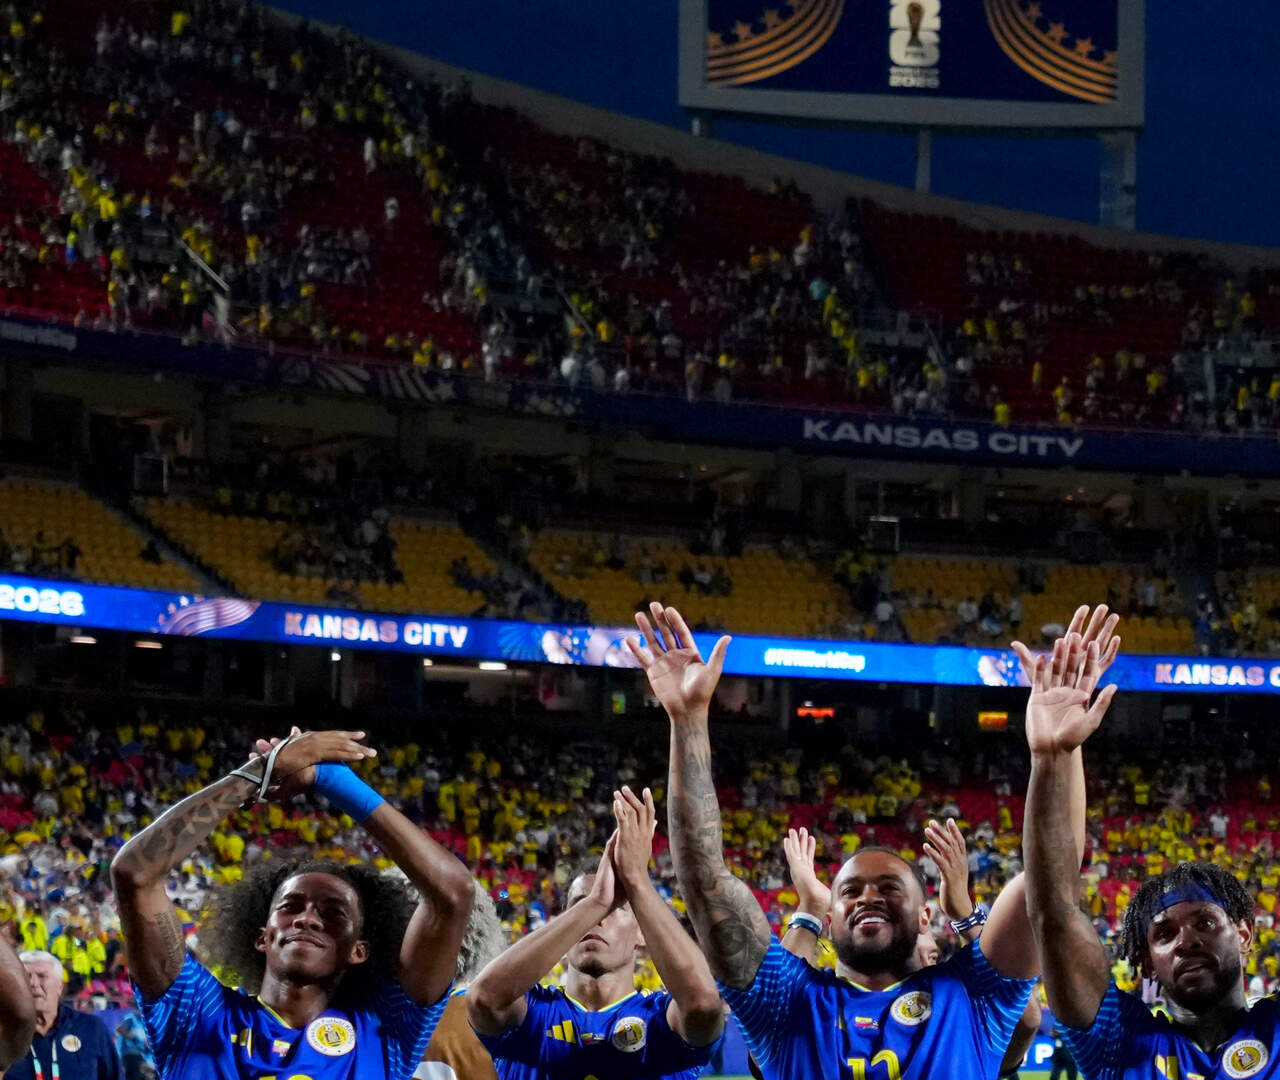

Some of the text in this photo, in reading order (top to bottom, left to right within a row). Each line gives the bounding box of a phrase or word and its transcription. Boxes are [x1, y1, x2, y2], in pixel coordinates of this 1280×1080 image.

[803, 418, 1083, 458] KANSAS CITY
[0, 584, 85, 617] 2026
[284, 612, 468, 648] KANSAS CITY
[1155, 663, 1265, 686] KANSAS
